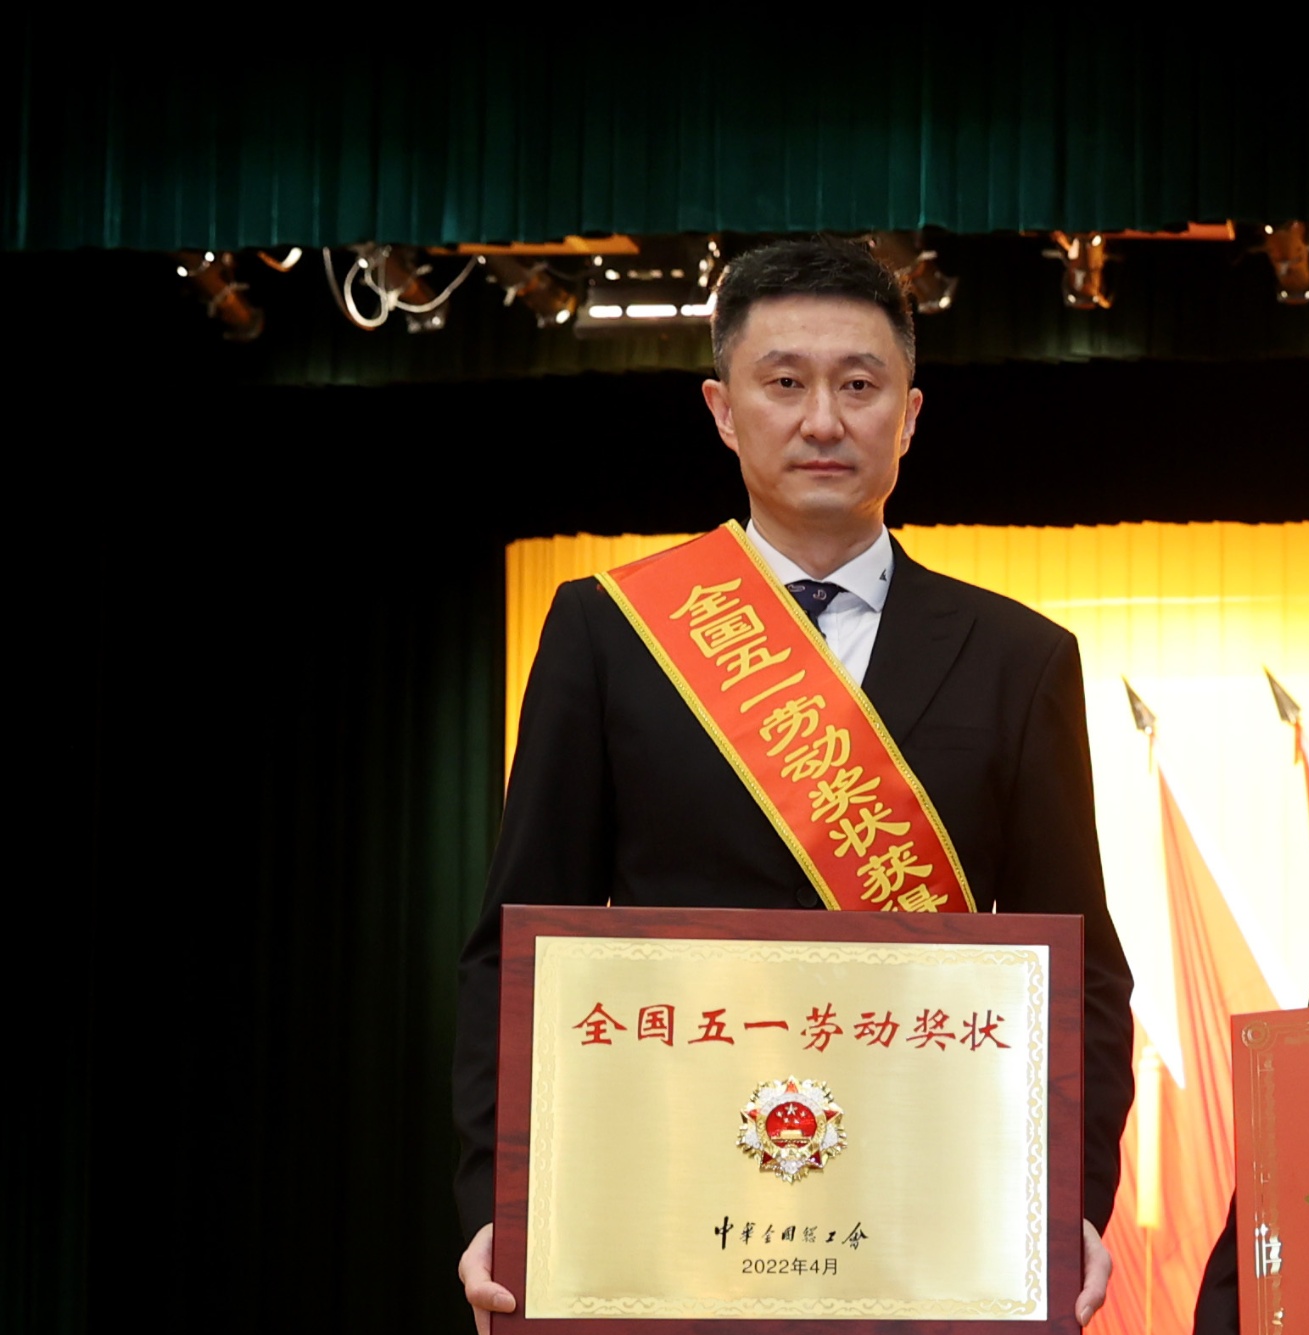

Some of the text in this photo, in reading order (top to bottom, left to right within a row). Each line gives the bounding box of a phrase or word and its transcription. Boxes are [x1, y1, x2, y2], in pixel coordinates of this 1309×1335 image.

[571, 1002, 1012, 1052] 全国五一劳动奖状
[742, 1257, 838, 1276] 2022年4月
